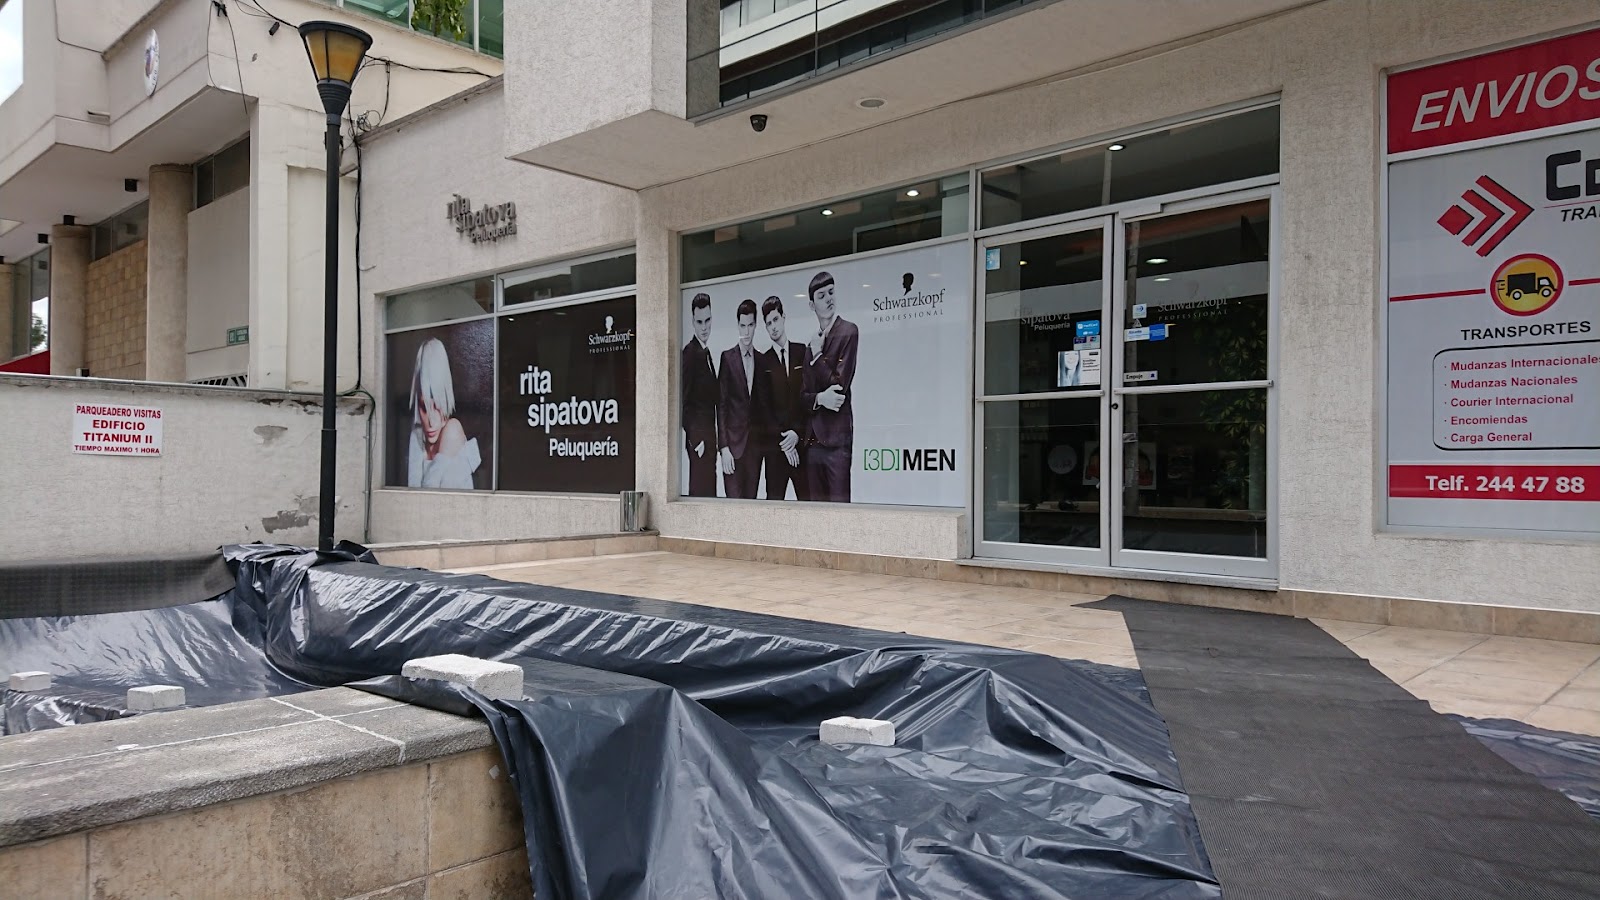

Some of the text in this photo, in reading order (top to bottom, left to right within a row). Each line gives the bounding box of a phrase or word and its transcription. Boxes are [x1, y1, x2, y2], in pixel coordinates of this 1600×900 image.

[446, 193, 471, 219] rita
[455, 202, 516, 233] sipatova
[1561, 206, 1600, 222] TRA
[873, 288, 946, 312] Schwarzkopf
[873, 309, 944, 323] PROFESSIONAL
[588, 329, 632, 345] Schwarzkopf
[1461, 321, 1591, 341] TRANSPORTES
[589, 345, 631, 354] PROFESSIONAL
[1450, 361, 1507, 371] Mudanzas
[520, 365, 552, 395] rita
[1450, 375, 1578, 389] Mudanzas Nacionales
[1450, 393, 1574, 408] Courier Internacional
[76, 405, 162, 419] PARQUEADERO VISITAS
[527, 396, 619, 434] sipatova
[92, 419, 146, 431] EDIFICIO
[1450, 415, 1528, 426] Encomiendas
[83, 432, 153, 444] TITANIUM II
[1450, 432, 1533, 445] Carga General
[549, 436, 619, 461] Peluquería
[1425, 475, 1586, 493] Telf. 244 47 88
